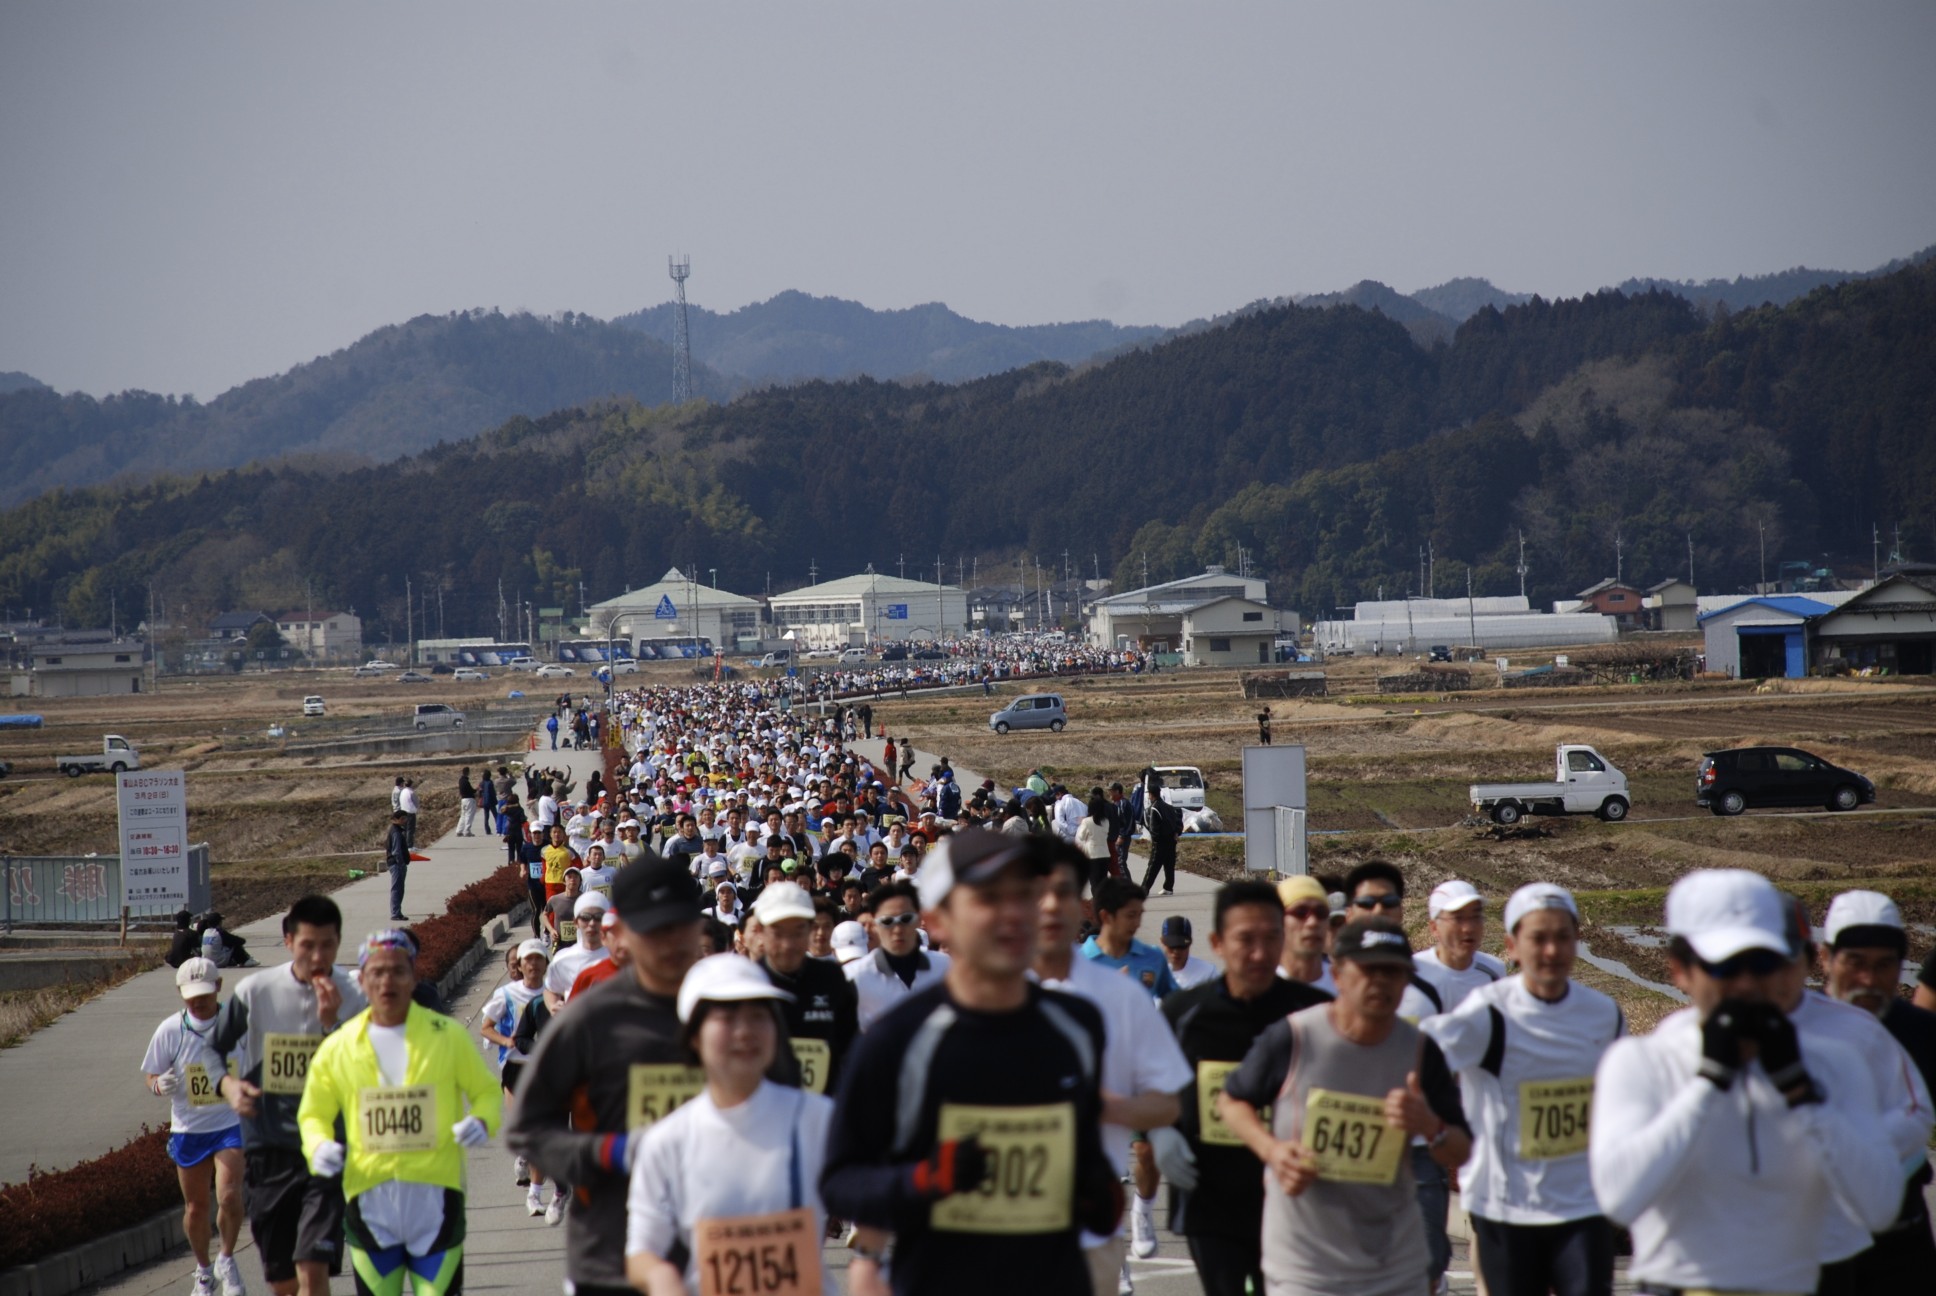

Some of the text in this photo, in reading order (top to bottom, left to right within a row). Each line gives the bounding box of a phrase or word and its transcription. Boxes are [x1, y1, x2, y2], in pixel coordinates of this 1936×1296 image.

[271, 1051, 315, 1078] 503
[365, 1104, 423, 1137] 10448
[1313, 1115, 1384, 1161] 6437
[706, 1241, 798, 1295] 12154
